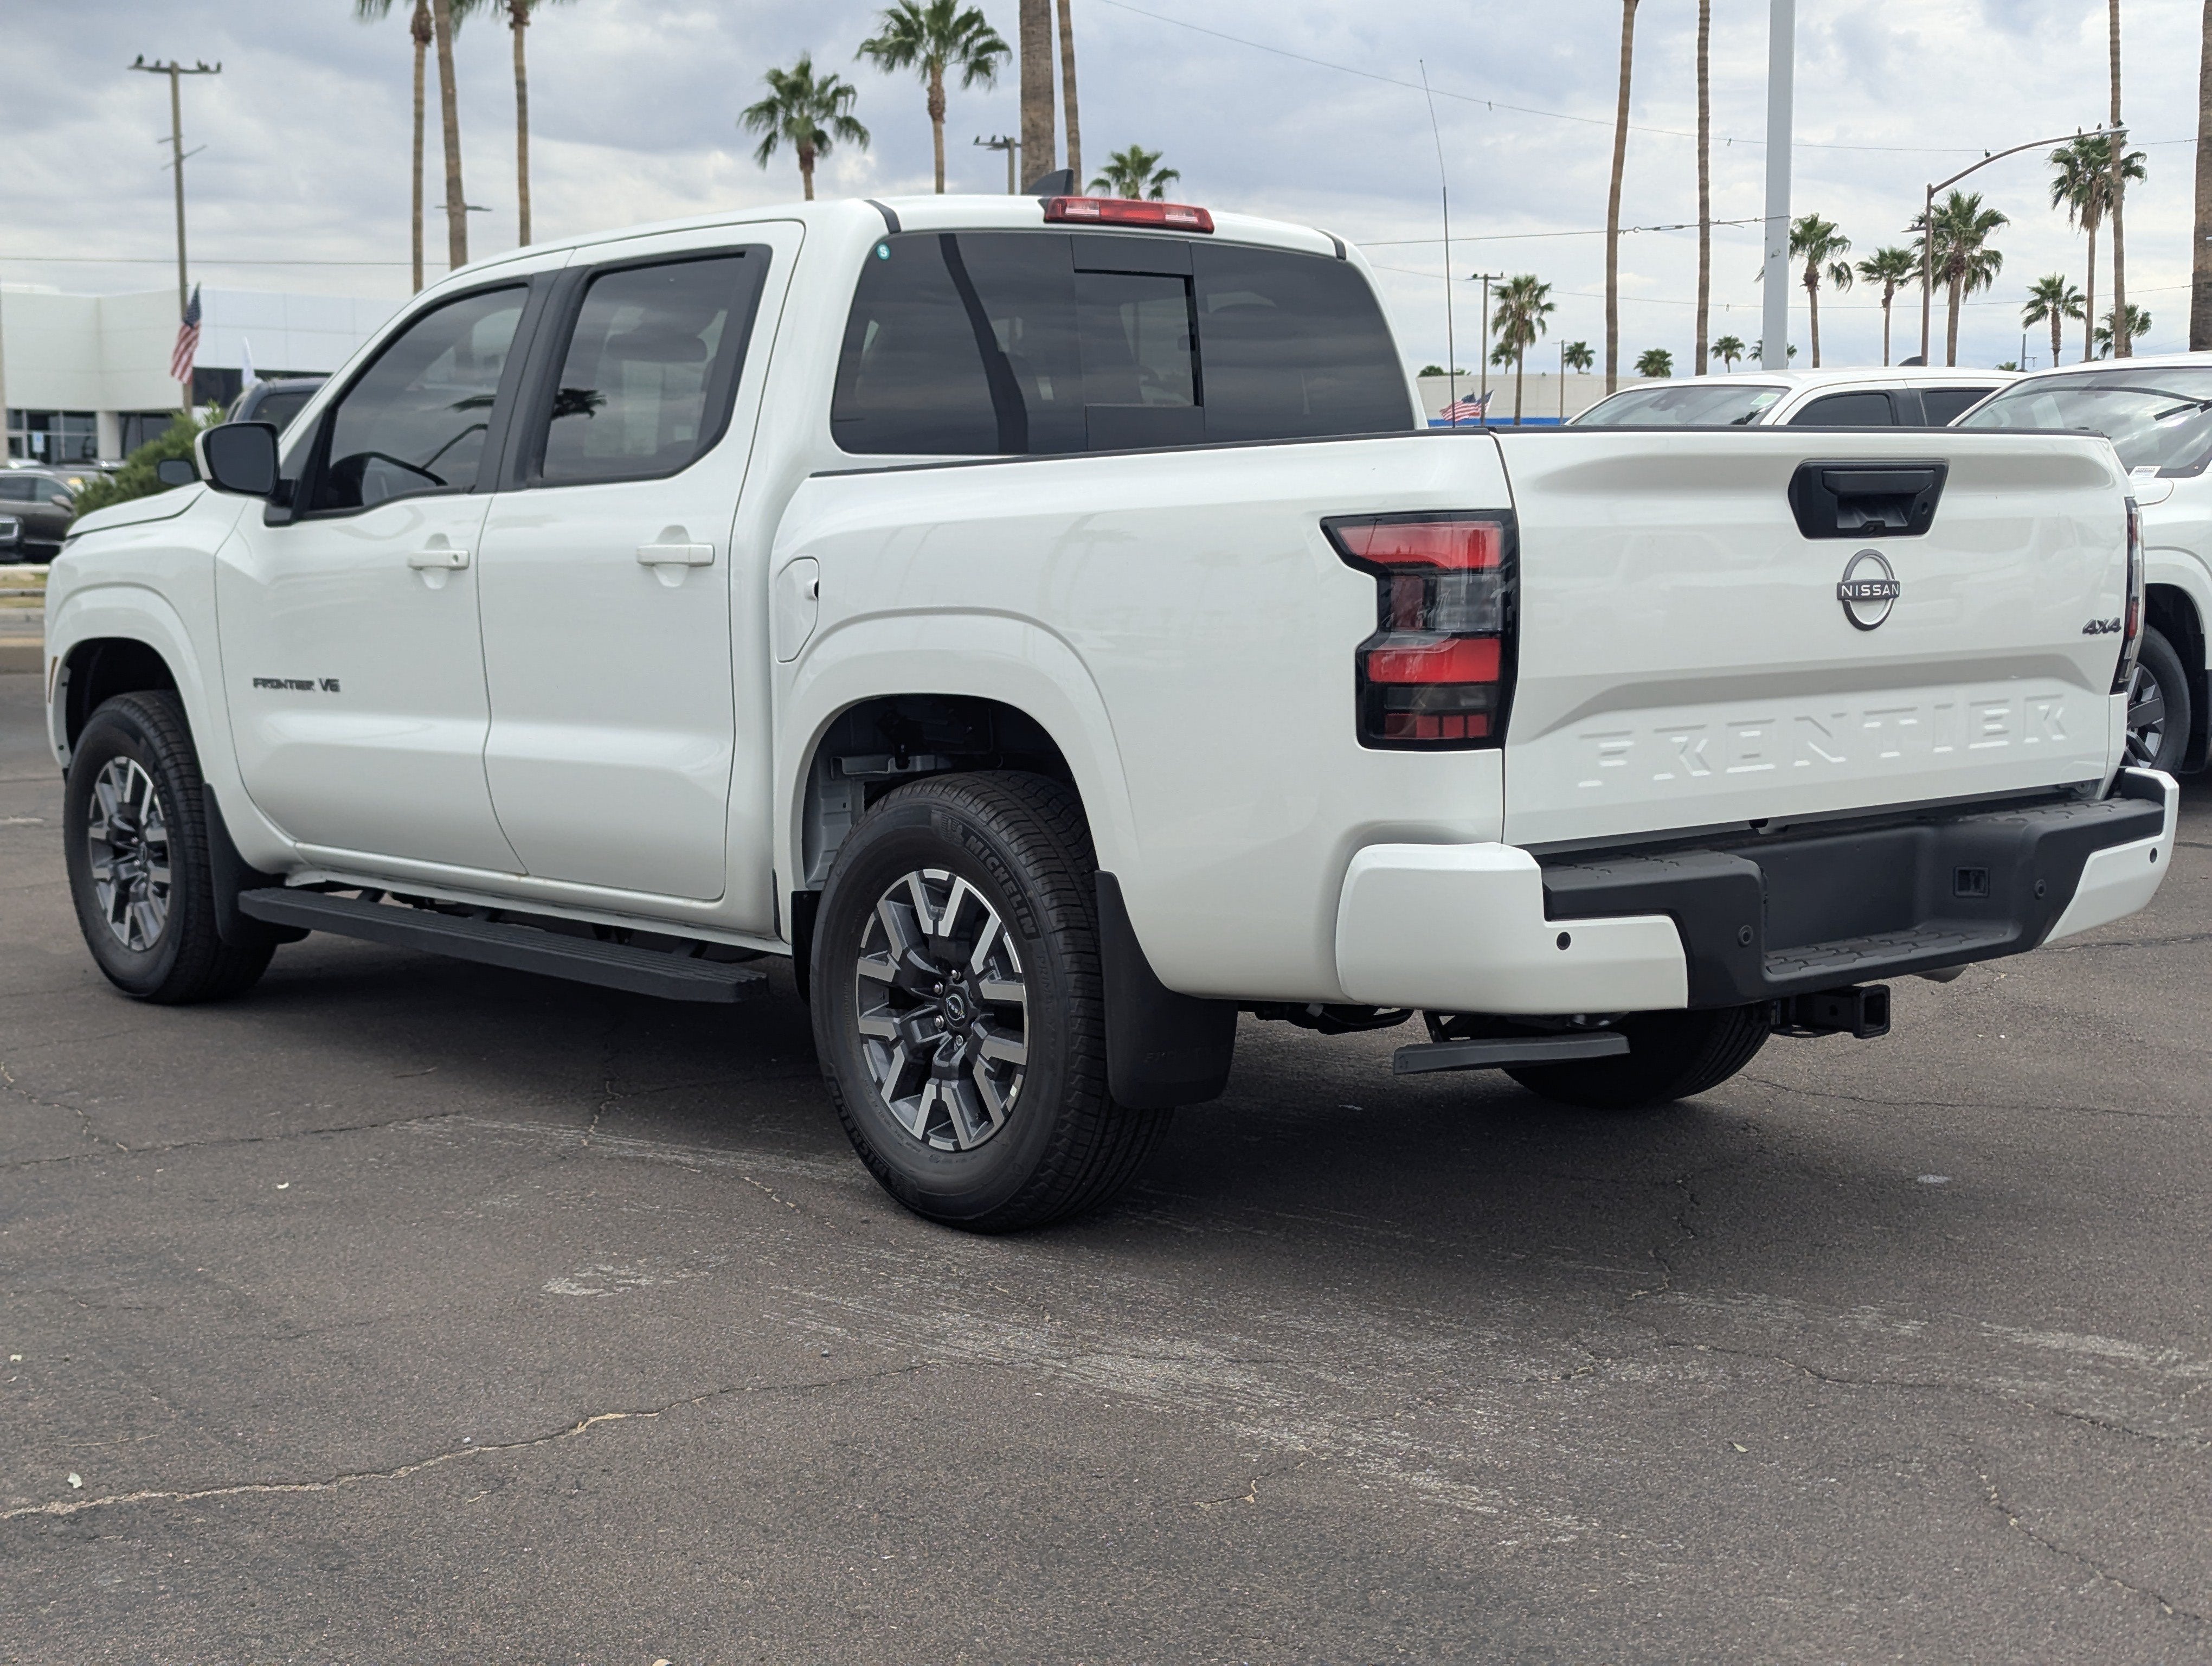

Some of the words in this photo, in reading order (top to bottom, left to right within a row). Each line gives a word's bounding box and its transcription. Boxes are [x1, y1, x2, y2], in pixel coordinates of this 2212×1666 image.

[1841, 584, 1899, 597] NISSAN
[253, 677, 316, 692] FRONTIER
[318, 678, 341, 693] V6
[1577, 694, 2069, 789] FRONTIER
[964, 835, 1037, 934] MICHELIN
